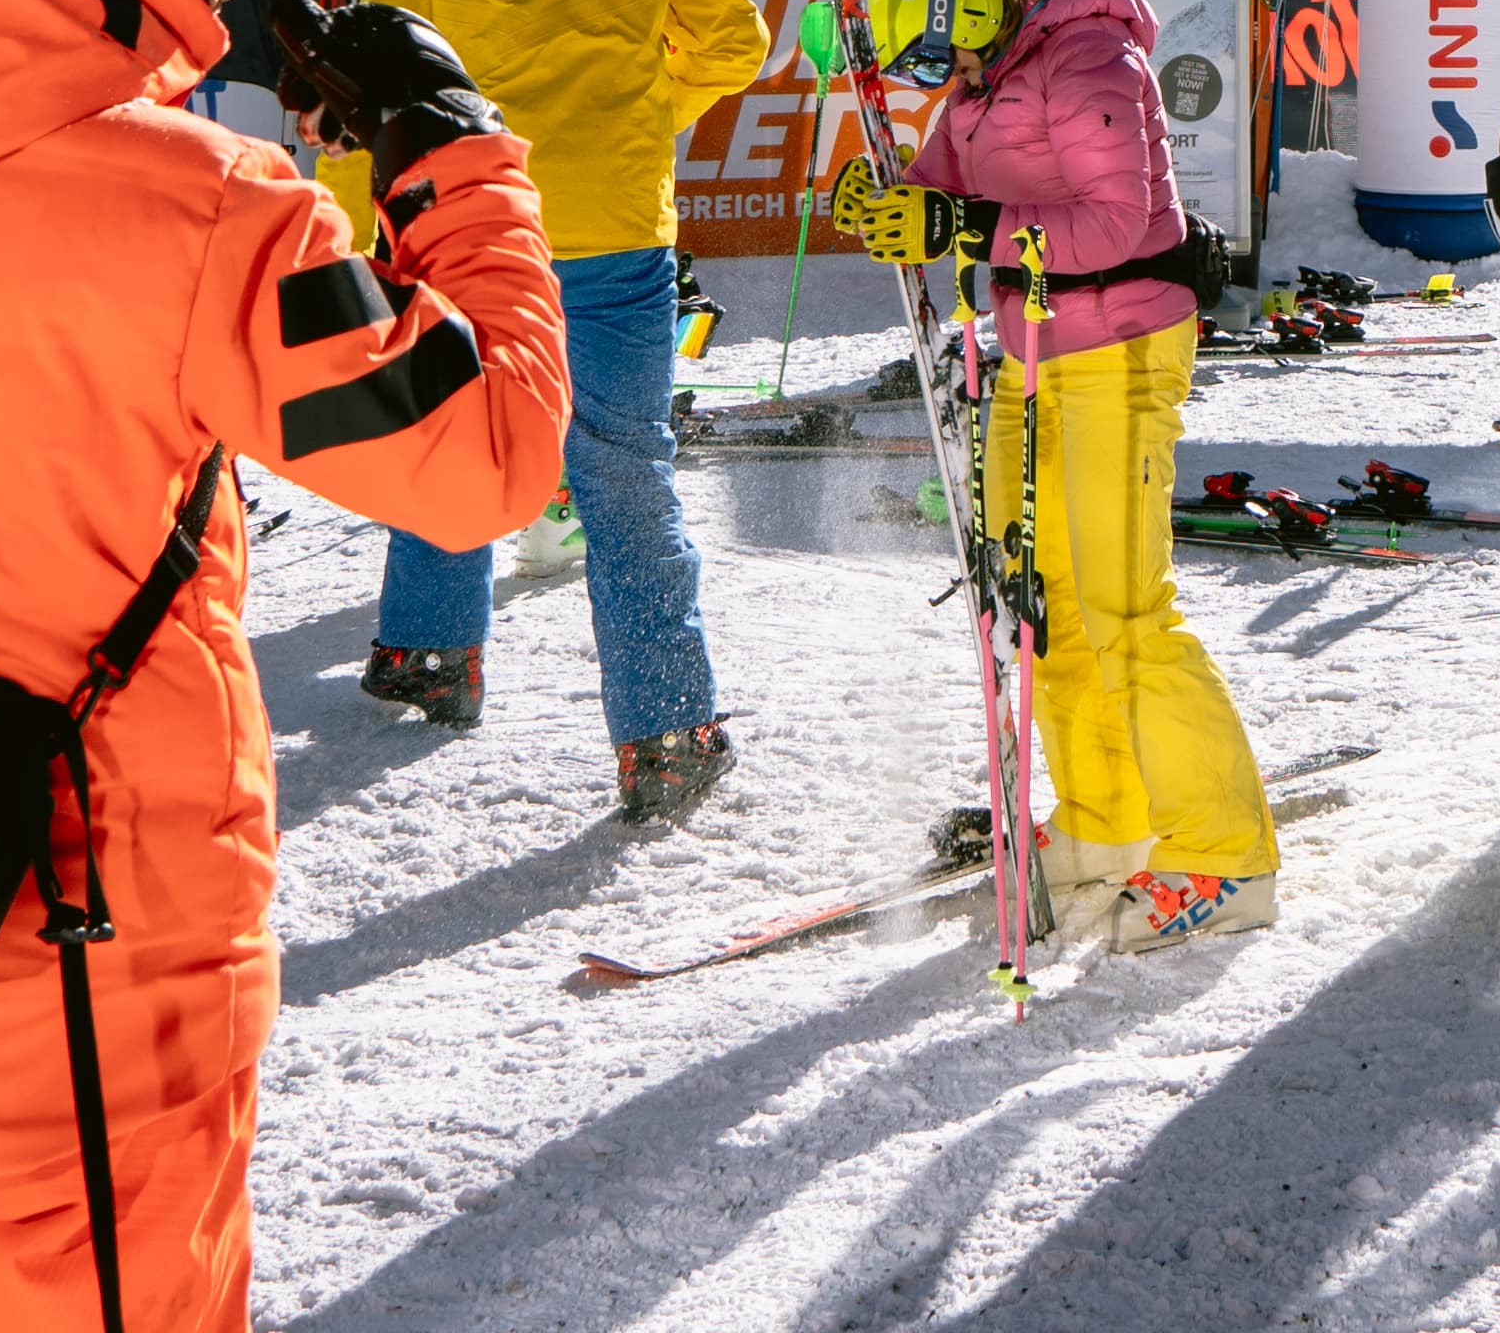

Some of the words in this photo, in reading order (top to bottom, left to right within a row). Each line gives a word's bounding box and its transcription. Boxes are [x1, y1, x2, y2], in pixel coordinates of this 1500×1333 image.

[933, 203, 942, 241] LEVEL
[1029, 273, 1041, 306] LEKI
[971, 406, 983, 472] LEKI
[972, 480, 984, 546] LEKI
[1022, 483, 1035, 549] LEKI
